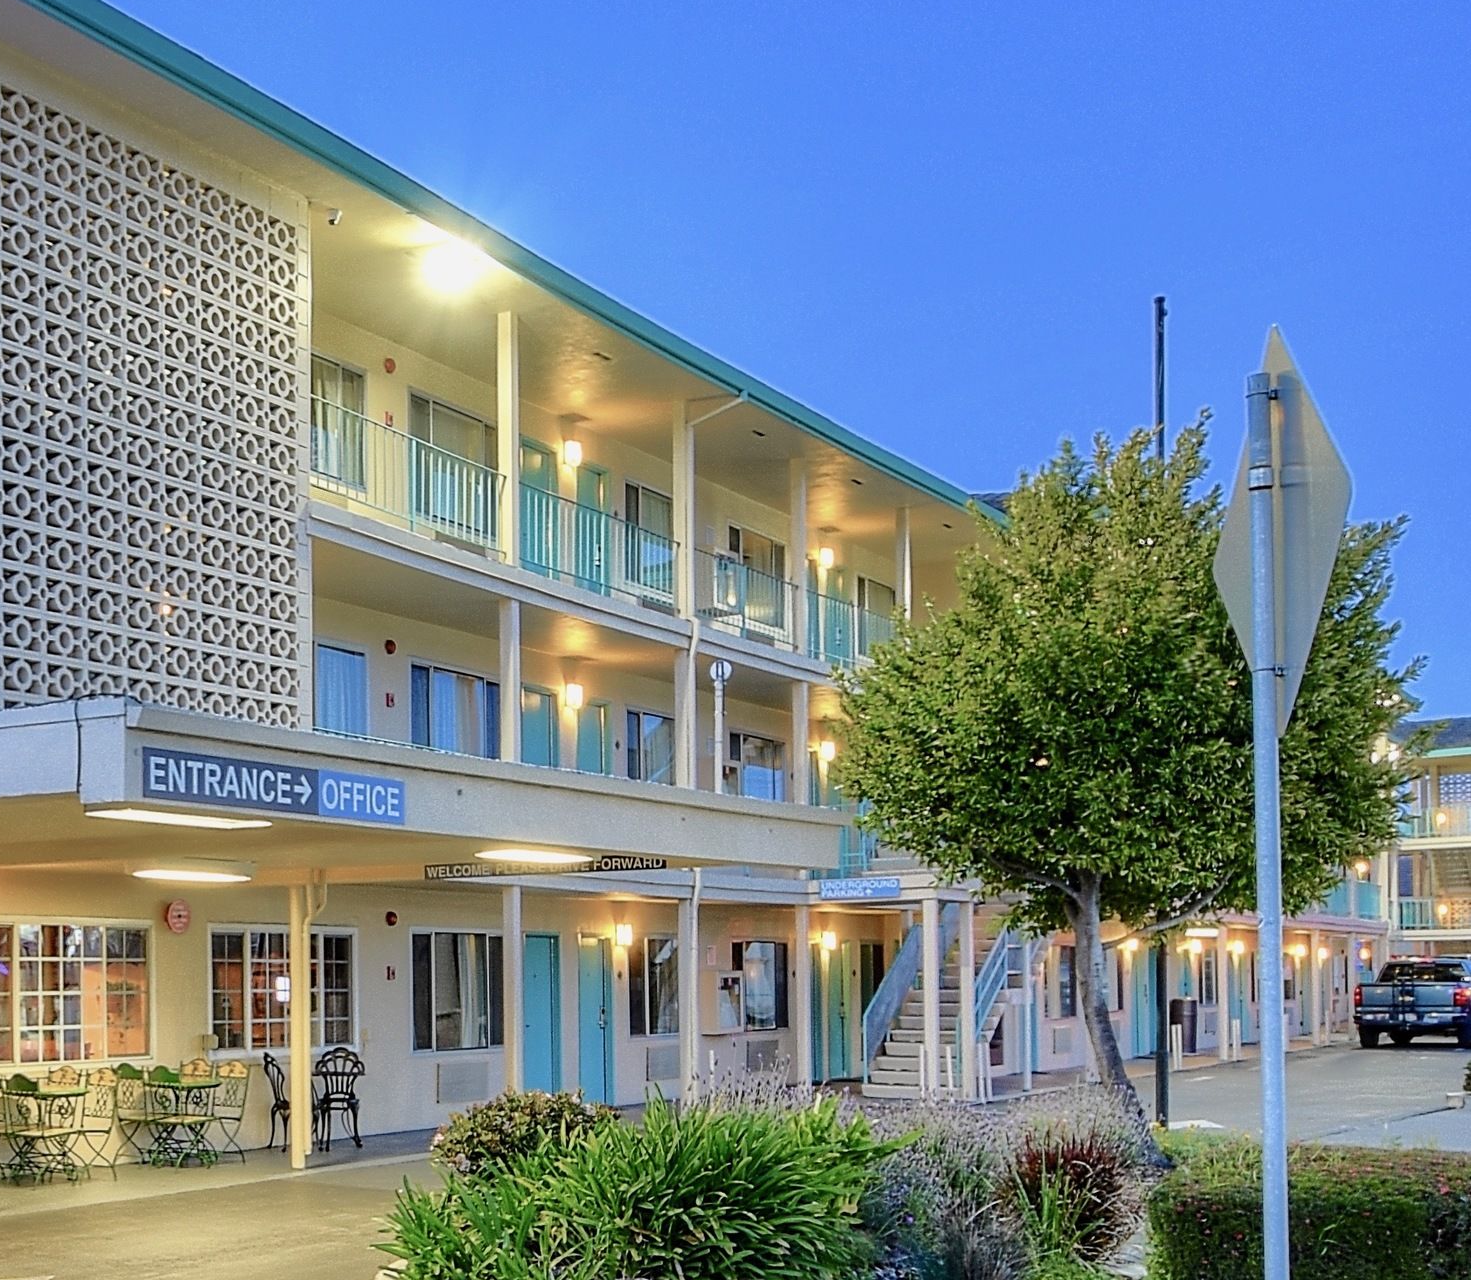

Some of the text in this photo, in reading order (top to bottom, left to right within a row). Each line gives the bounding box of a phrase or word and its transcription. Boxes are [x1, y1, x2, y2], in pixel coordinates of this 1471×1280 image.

[149, 756, 400, 817] ENTRANCE OFFICE
[427, 865, 490, 878] WELCOME
[593, 858, 664, 870] FORWARD
[821, 879, 898, 889] UNDERGROUND
[821, 887, 864, 897] PARKING
